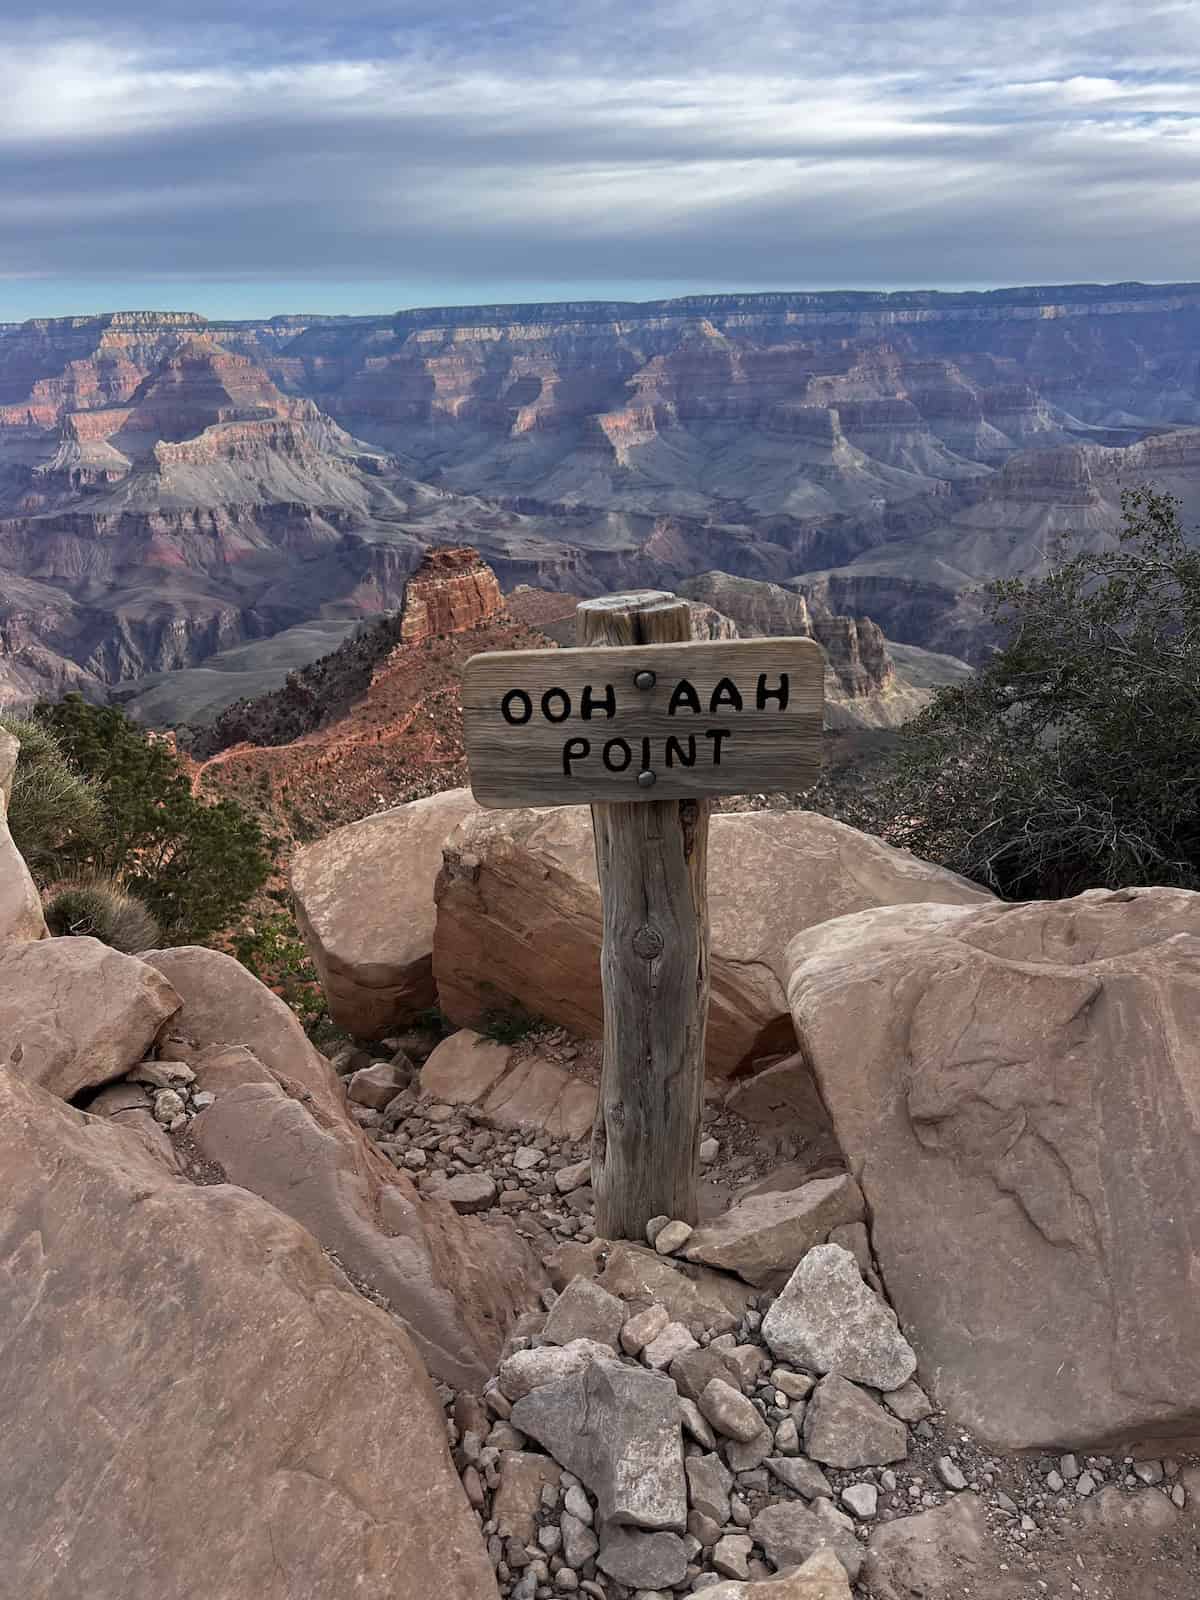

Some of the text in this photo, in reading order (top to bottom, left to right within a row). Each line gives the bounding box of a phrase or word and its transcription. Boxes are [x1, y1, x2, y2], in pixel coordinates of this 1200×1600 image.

[501, 673, 789, 724] OOH AAH
[562, 729, 731, 776] POINT
